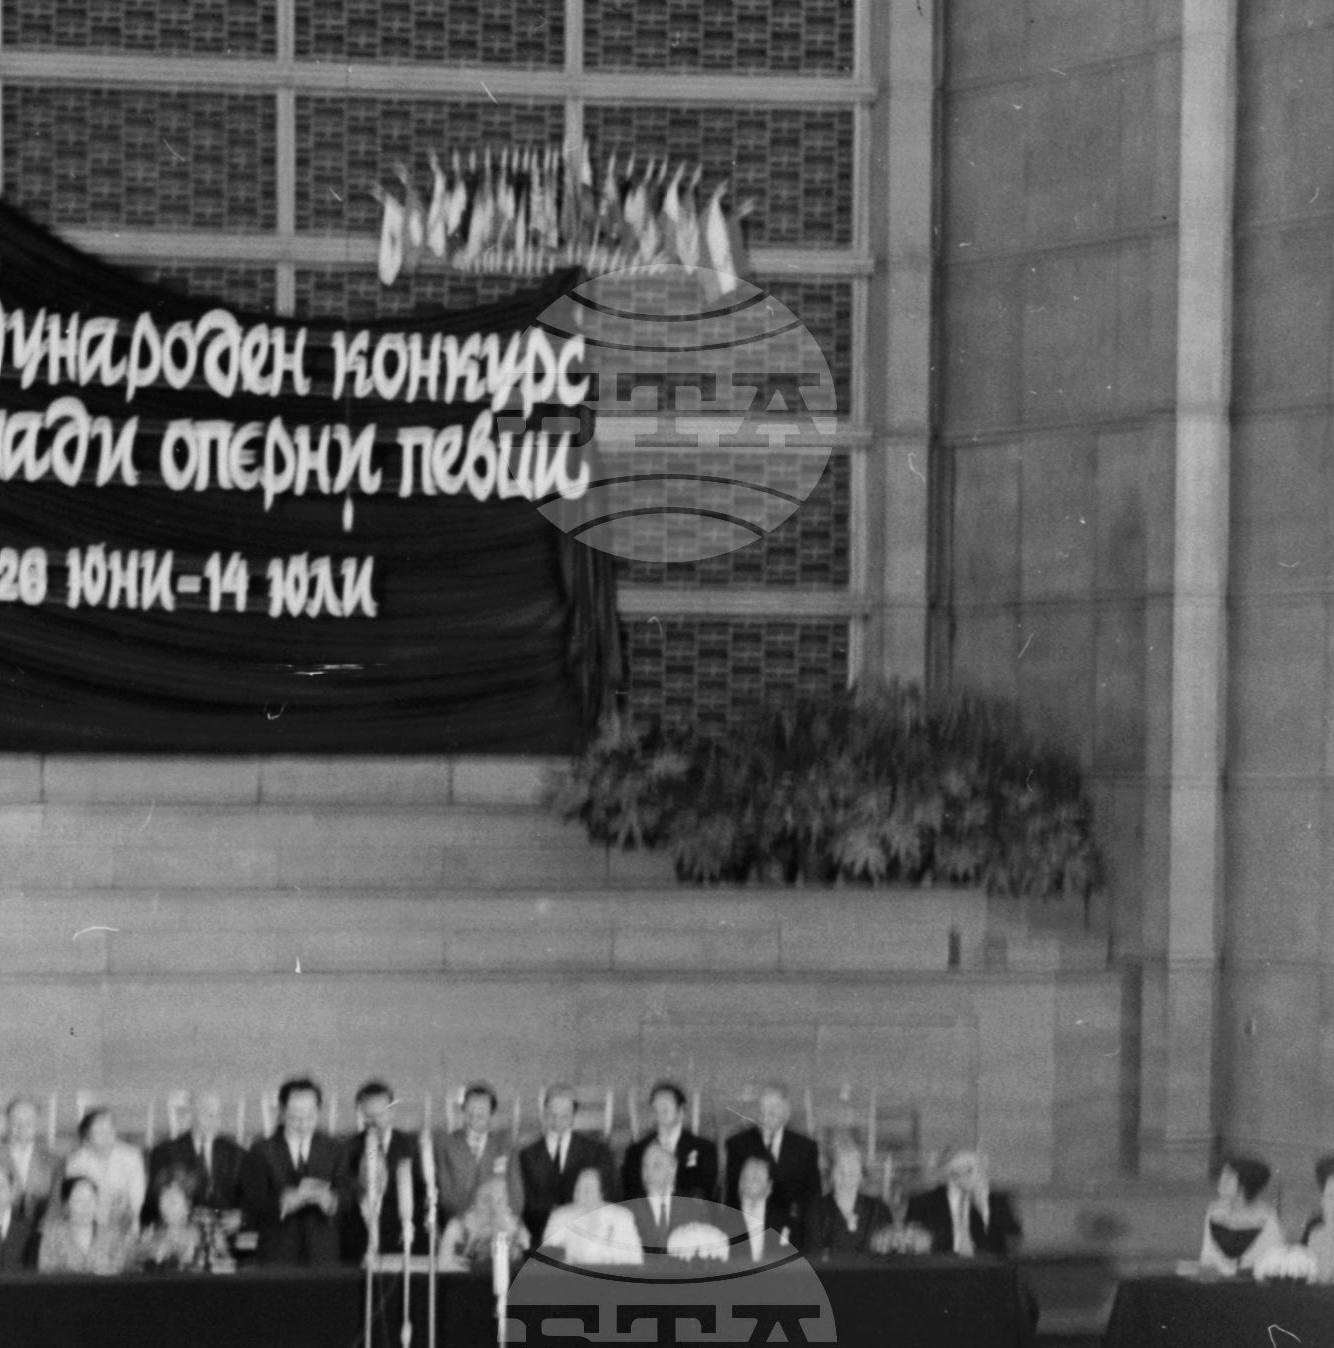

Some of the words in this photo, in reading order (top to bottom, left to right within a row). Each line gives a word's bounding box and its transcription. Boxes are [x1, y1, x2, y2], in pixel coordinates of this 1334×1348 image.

[331, 326, 590, 419] конкурс
[160, 415, 382, 513] оперни
[396, 408, 590, 502] певци
